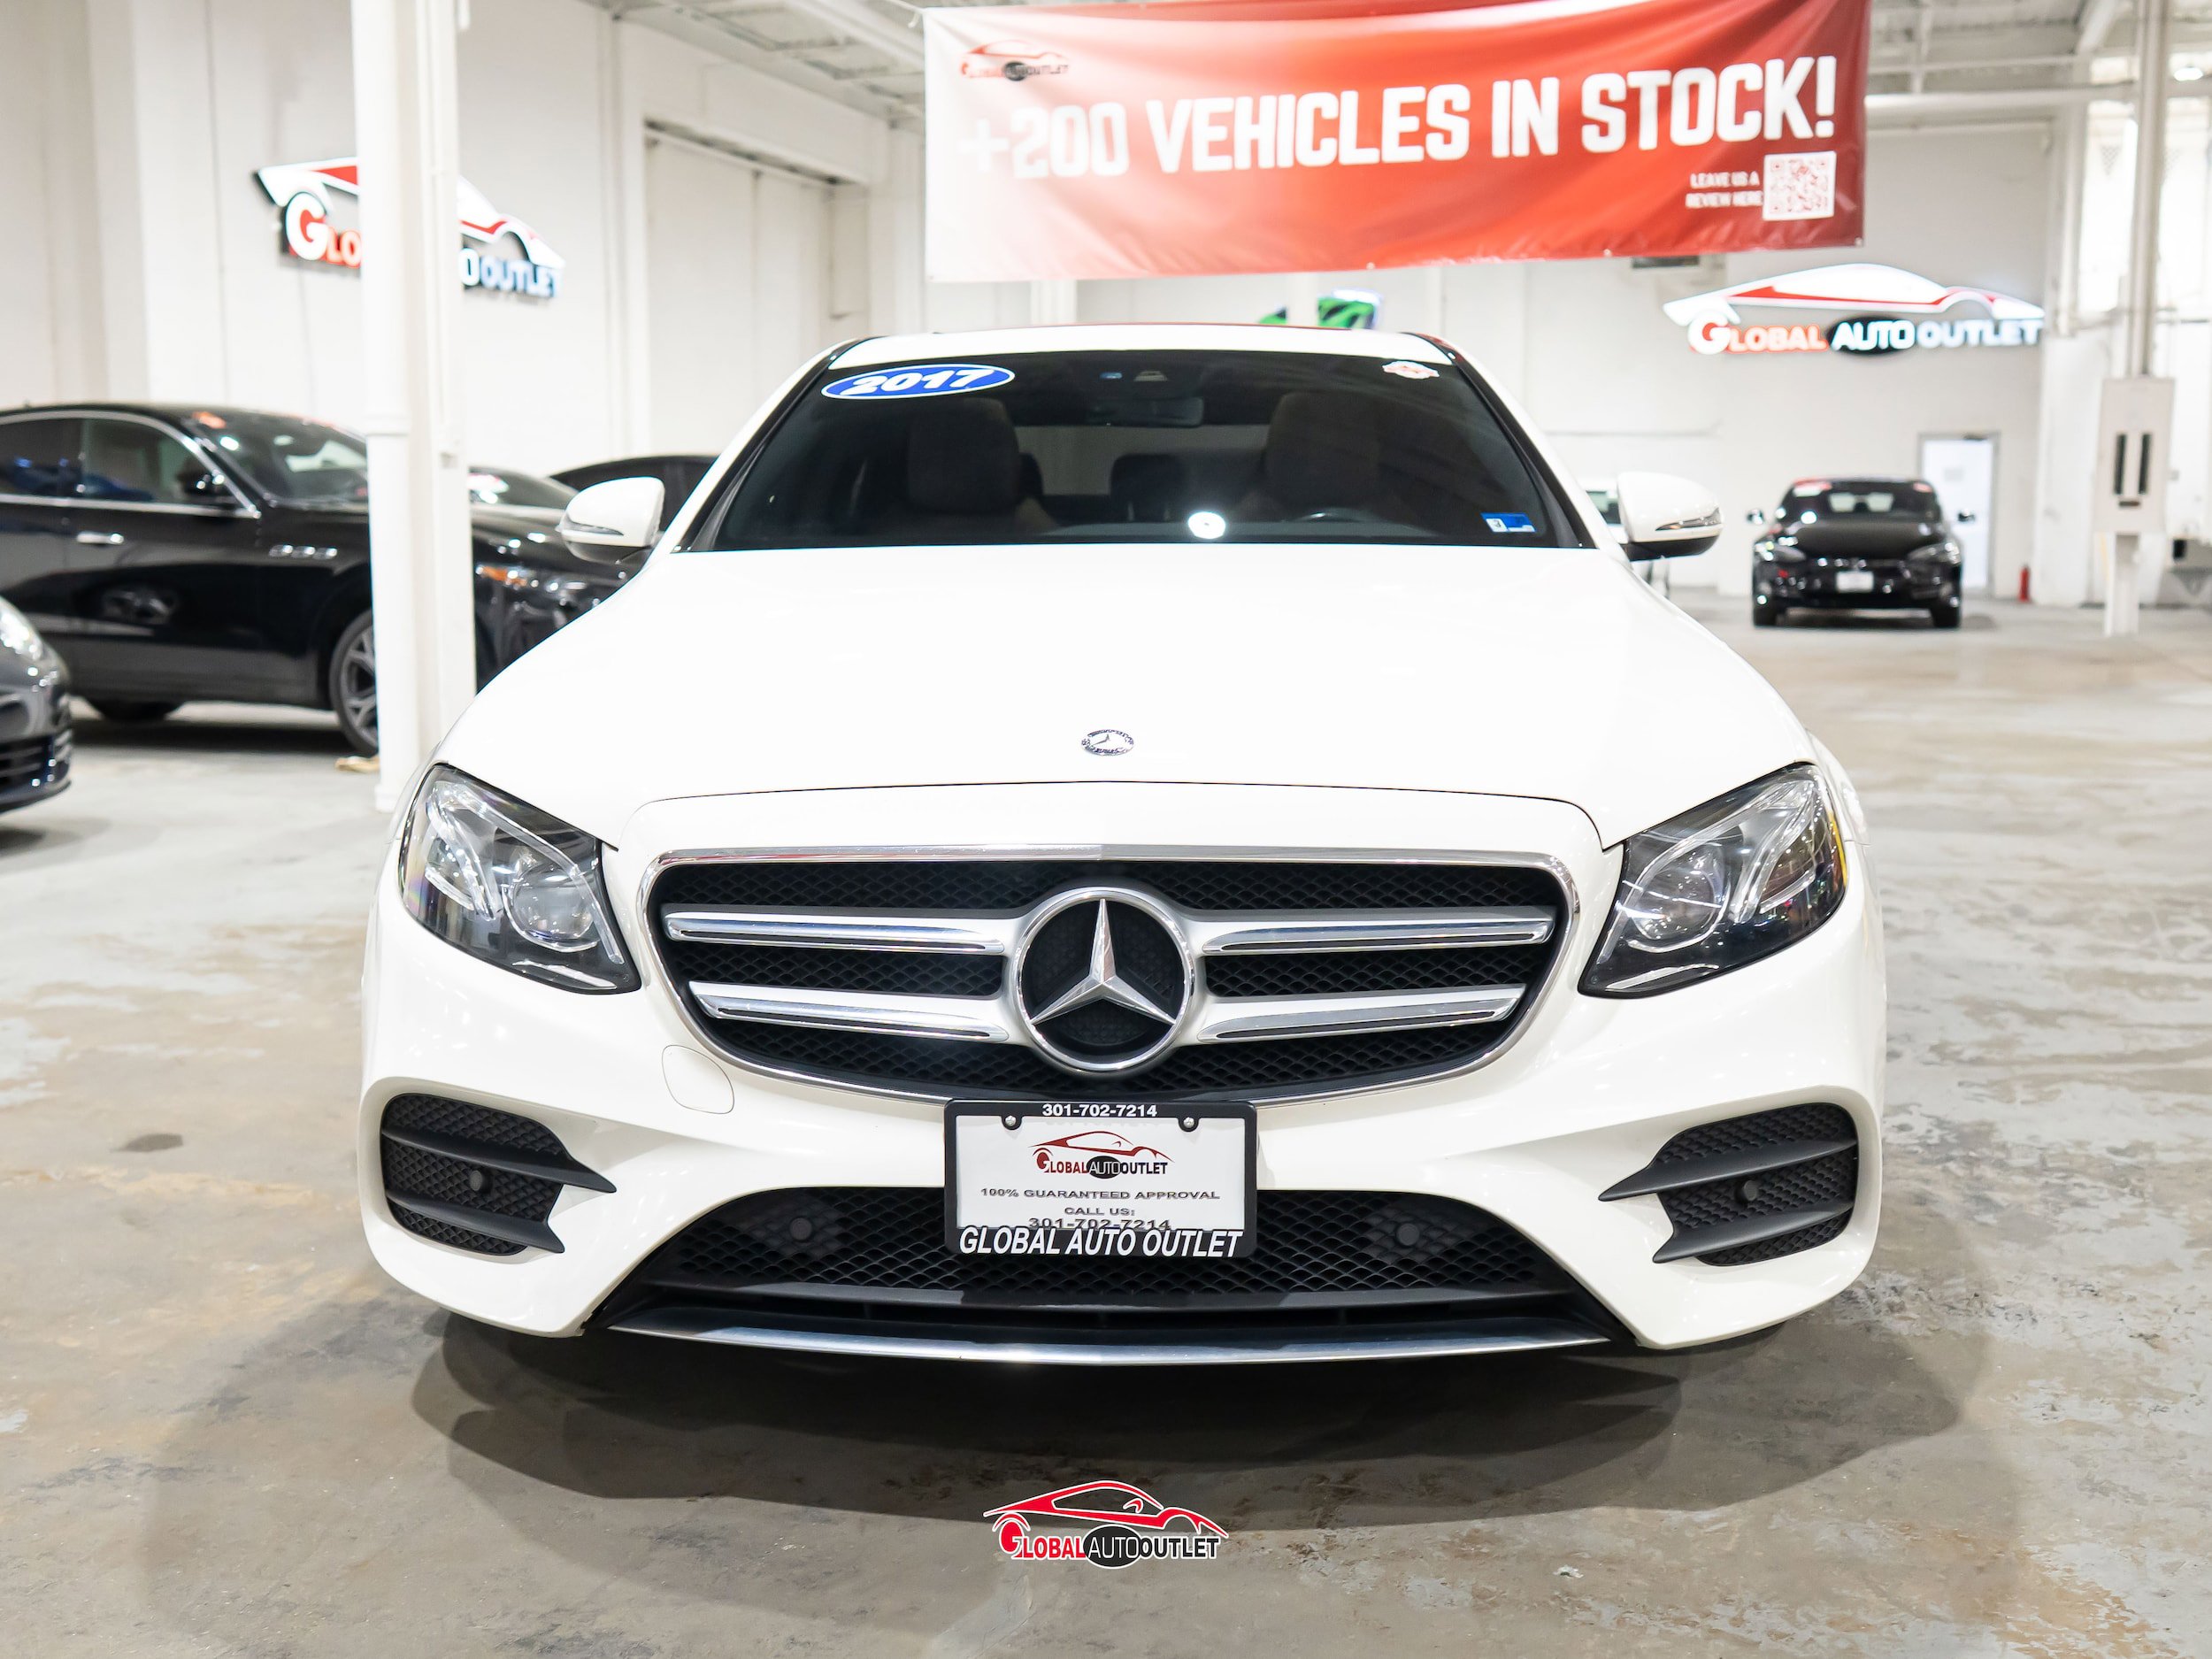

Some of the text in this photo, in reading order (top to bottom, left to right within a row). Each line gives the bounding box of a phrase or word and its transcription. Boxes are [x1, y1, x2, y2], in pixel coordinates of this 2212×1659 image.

[957, 56, 1837, 178] +200 VEHICLES IN STOCK!
[285, 191, 362, 268] GLO
[1688, 311, 2044, 355] GLOBAL AUTO OUTLET
[840, 369, 995, 396] 2017
[1041, 1102, 1158, 1118] 301-702-7214
[980, 1188, 1221, 1200] 100% GUARANTEED APPROVAL
[1028, 1217, 1171, 1231] 301-702-7214
[1064, 1207, 1135, 1217] CALL US:
[959, 1226, 1244, 1258] GLOBAL AUTO OUTLET
